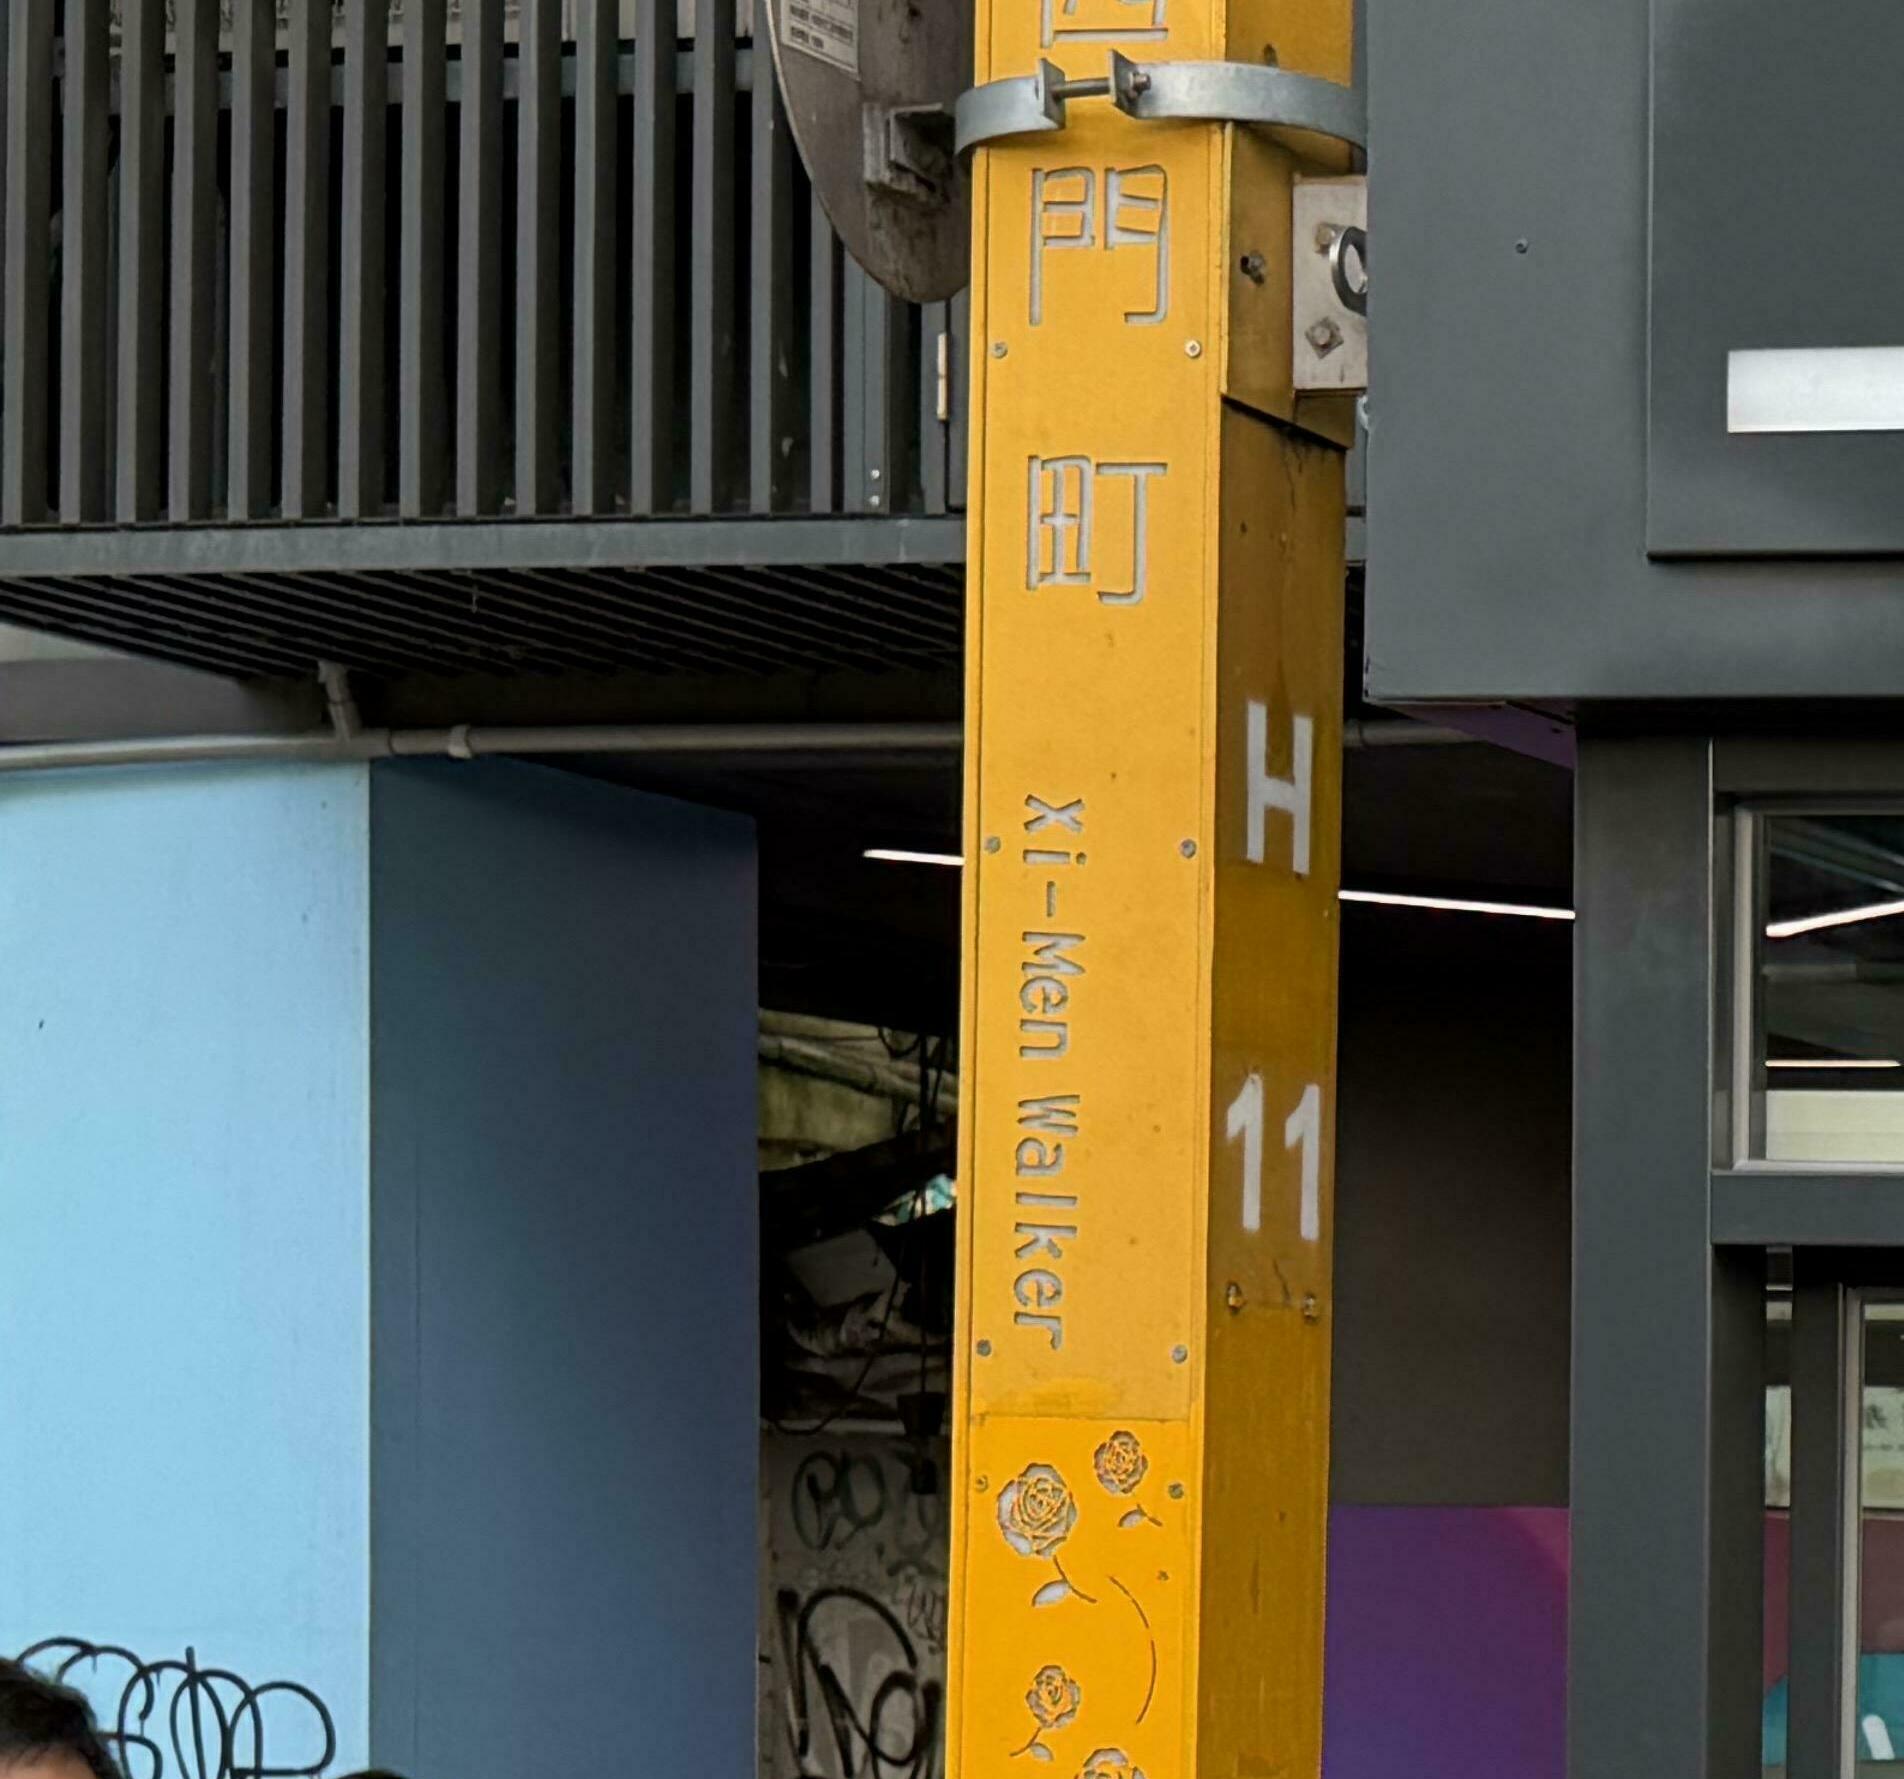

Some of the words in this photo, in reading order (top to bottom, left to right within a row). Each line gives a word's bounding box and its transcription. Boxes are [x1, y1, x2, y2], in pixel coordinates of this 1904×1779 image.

[1244, 700, 1313, 876] H
[1018, 793, 1087, 1061] Xi-Men
[1012, 1093, 1081, 1351] Walker
[1226, 1072, 1321, 1242] 11
